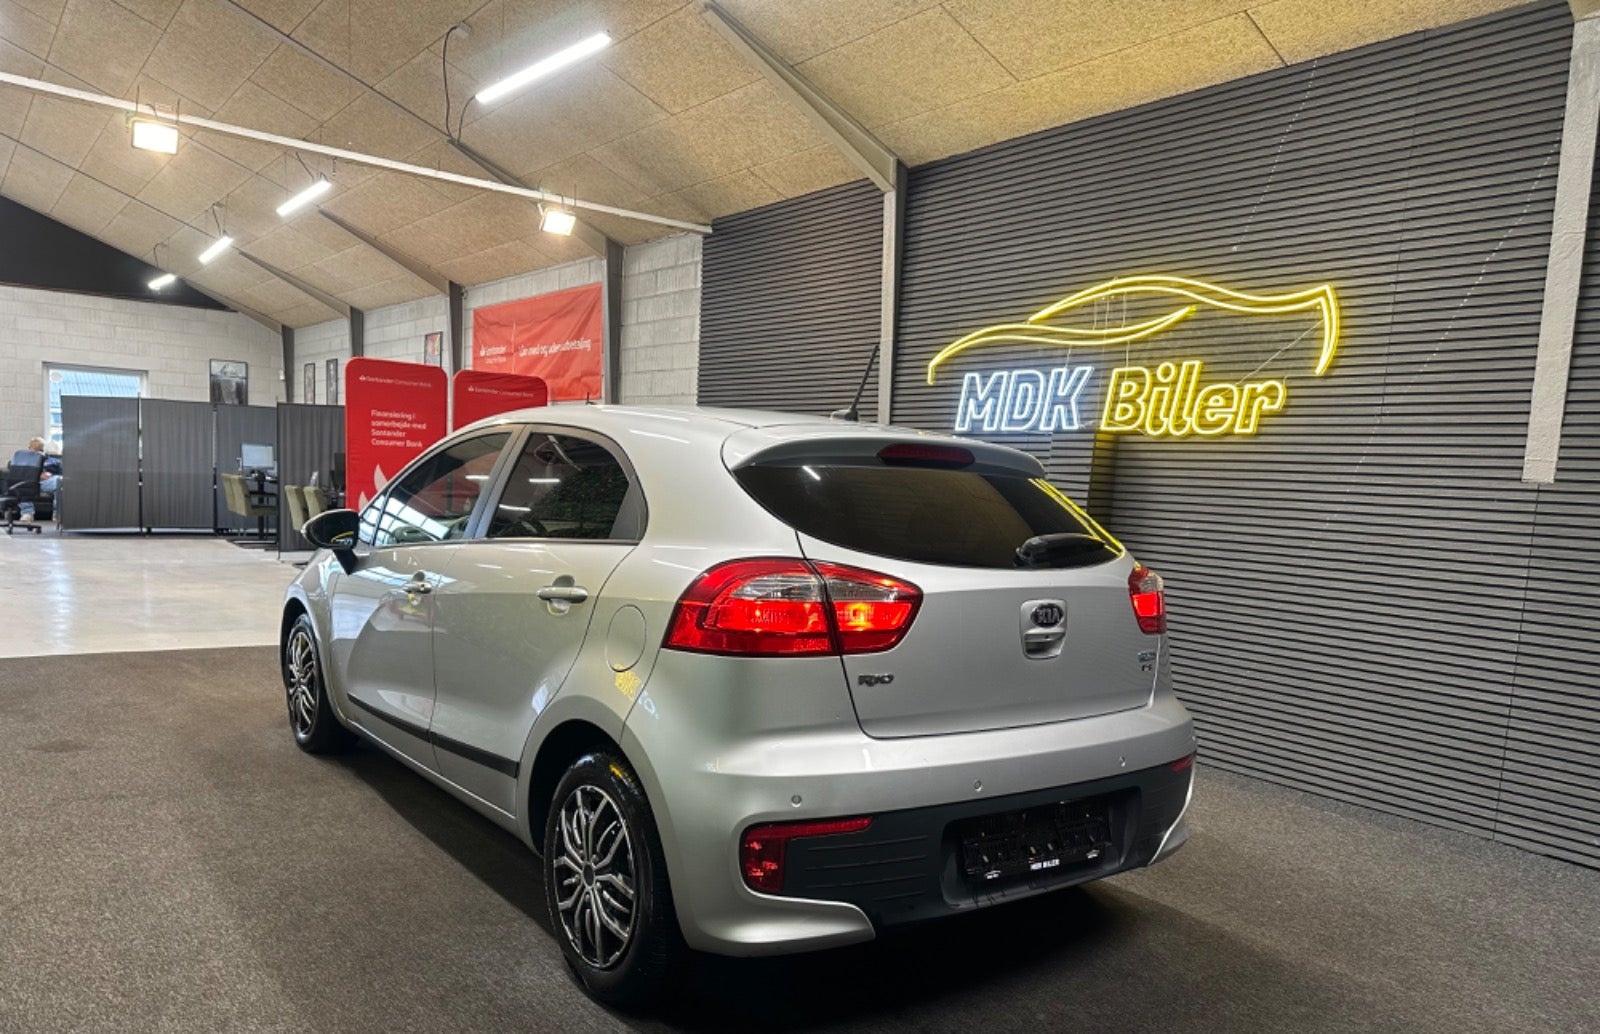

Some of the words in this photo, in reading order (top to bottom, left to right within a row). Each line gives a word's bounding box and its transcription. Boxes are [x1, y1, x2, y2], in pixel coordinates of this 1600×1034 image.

[954, 365, 1095, 433] MDK
[1100, 360, 1288, 437] Biler
[370, 408, 412, 421] Finansiering
[411, 422, 427, 430] med
[370, 428, 406, 438] Santander
[371, 438, 406, 448] Consumer
[405, 439, 423, 448] Bank
